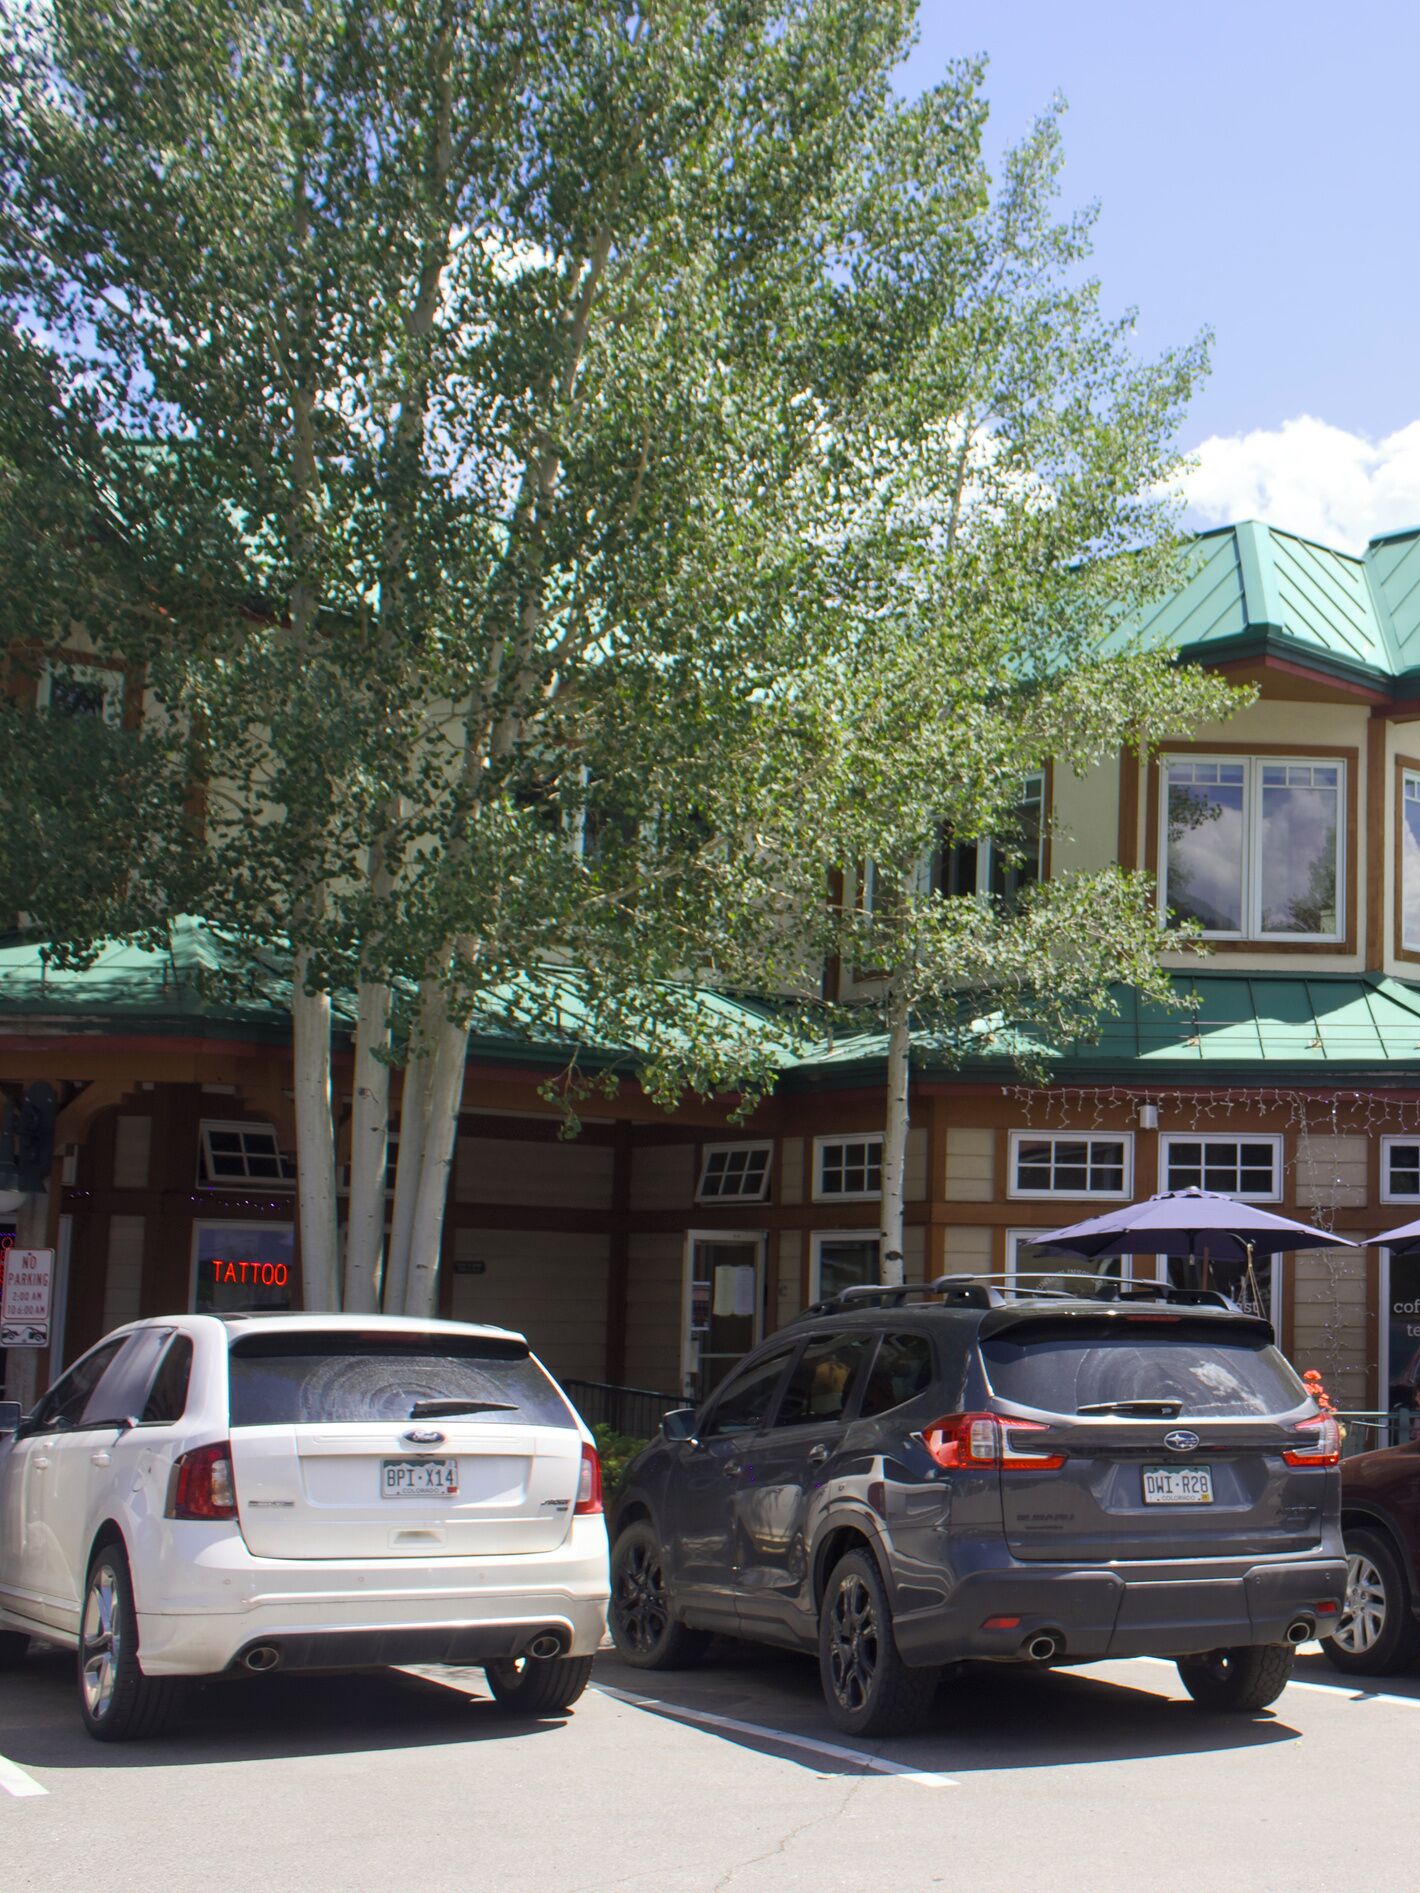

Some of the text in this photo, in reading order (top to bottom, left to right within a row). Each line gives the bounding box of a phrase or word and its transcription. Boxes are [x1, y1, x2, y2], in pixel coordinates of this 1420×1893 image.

[22, 1255, 37, 1270] NO
[7, 1272, 49, 1287] PARKING
[212, 1260, 288, 1287] TATTOO
[32, 1292, 42, 1301] AM
[35, 1305, 45, 1314] AM
